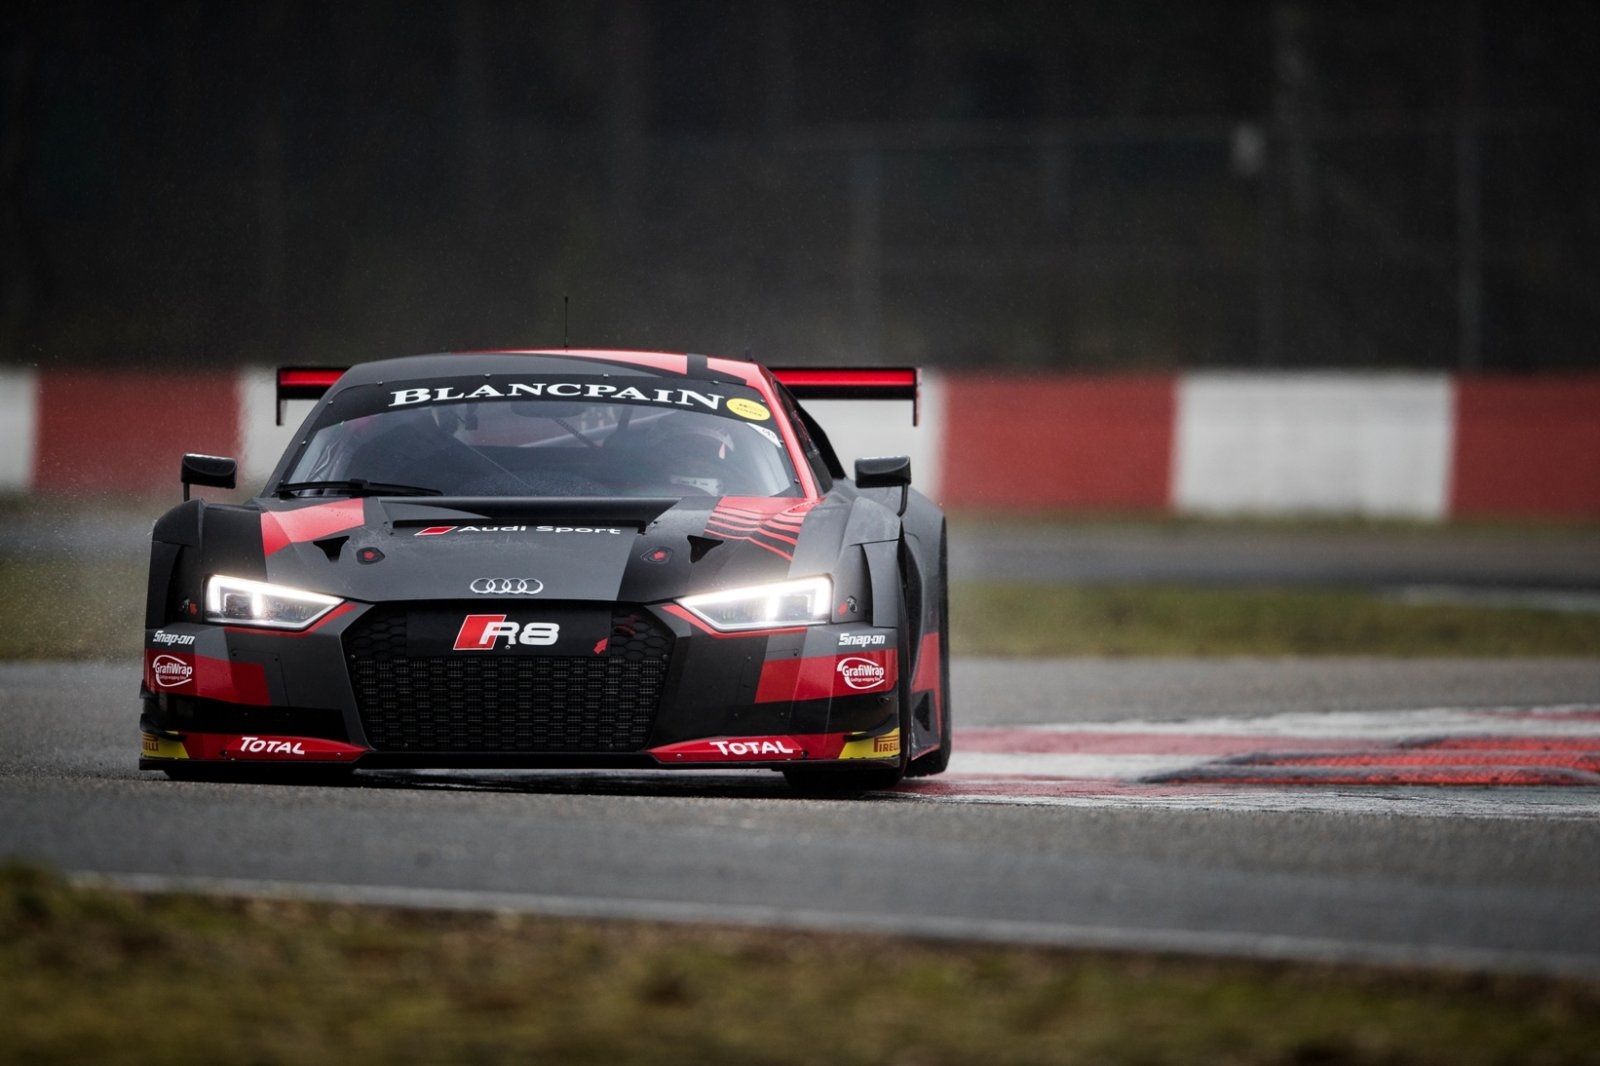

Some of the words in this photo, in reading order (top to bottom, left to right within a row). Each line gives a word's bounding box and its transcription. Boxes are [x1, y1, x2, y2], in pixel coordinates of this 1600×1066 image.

[388, 382, 724, 410] BLANCPAIN
[457, 525, 526, 533] Audi
[535, 525, 621, 535] Sport
[152, 630, 195, 646] Snap-on
[478, 621, 561, 646] R8
[838, 632, 886, 648] Snap-on
[155, 662, 193, 678] GrafiWrap
[842, 664, 885, 679] GrafiWrap
